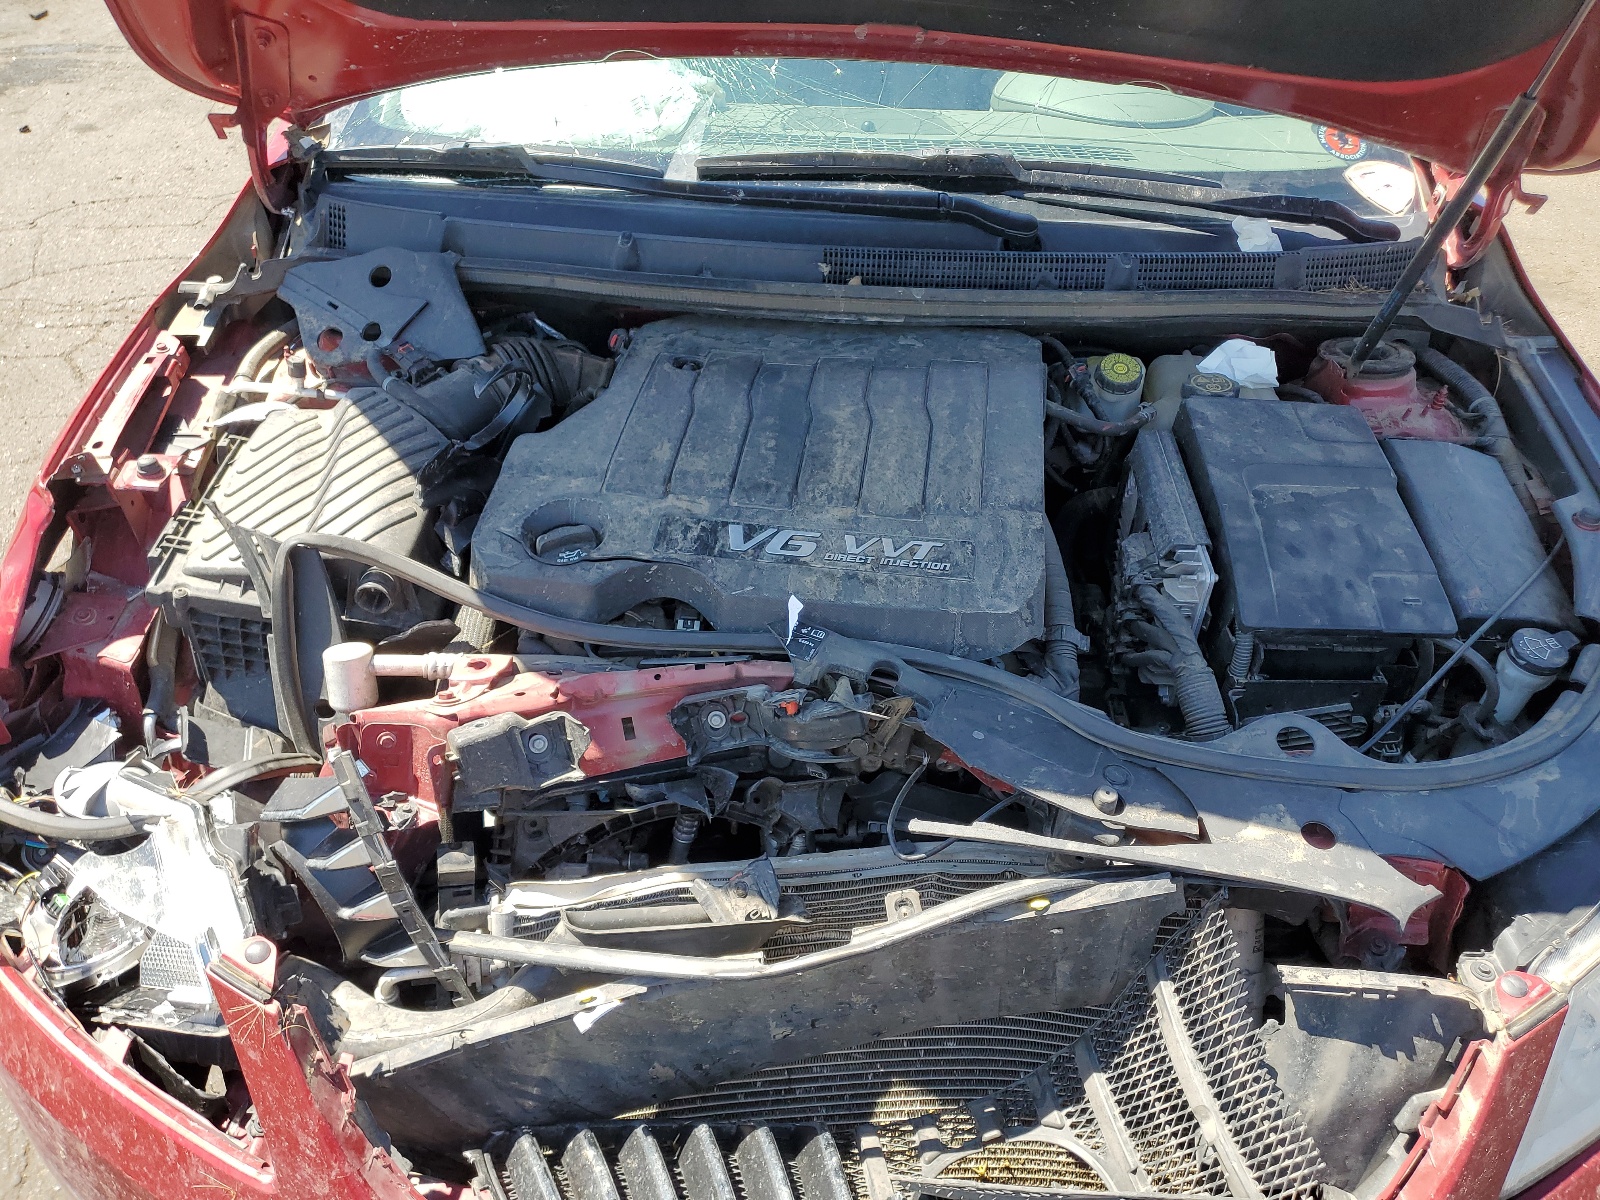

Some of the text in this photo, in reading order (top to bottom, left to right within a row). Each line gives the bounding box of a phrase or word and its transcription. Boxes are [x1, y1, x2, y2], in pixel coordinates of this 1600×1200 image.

[1330, 142, 1367, 160] ASSOCIATION
[728, 524, 945, 560] V6 VVT
[823, 552, 951, 571] DIRECT INJECTION
